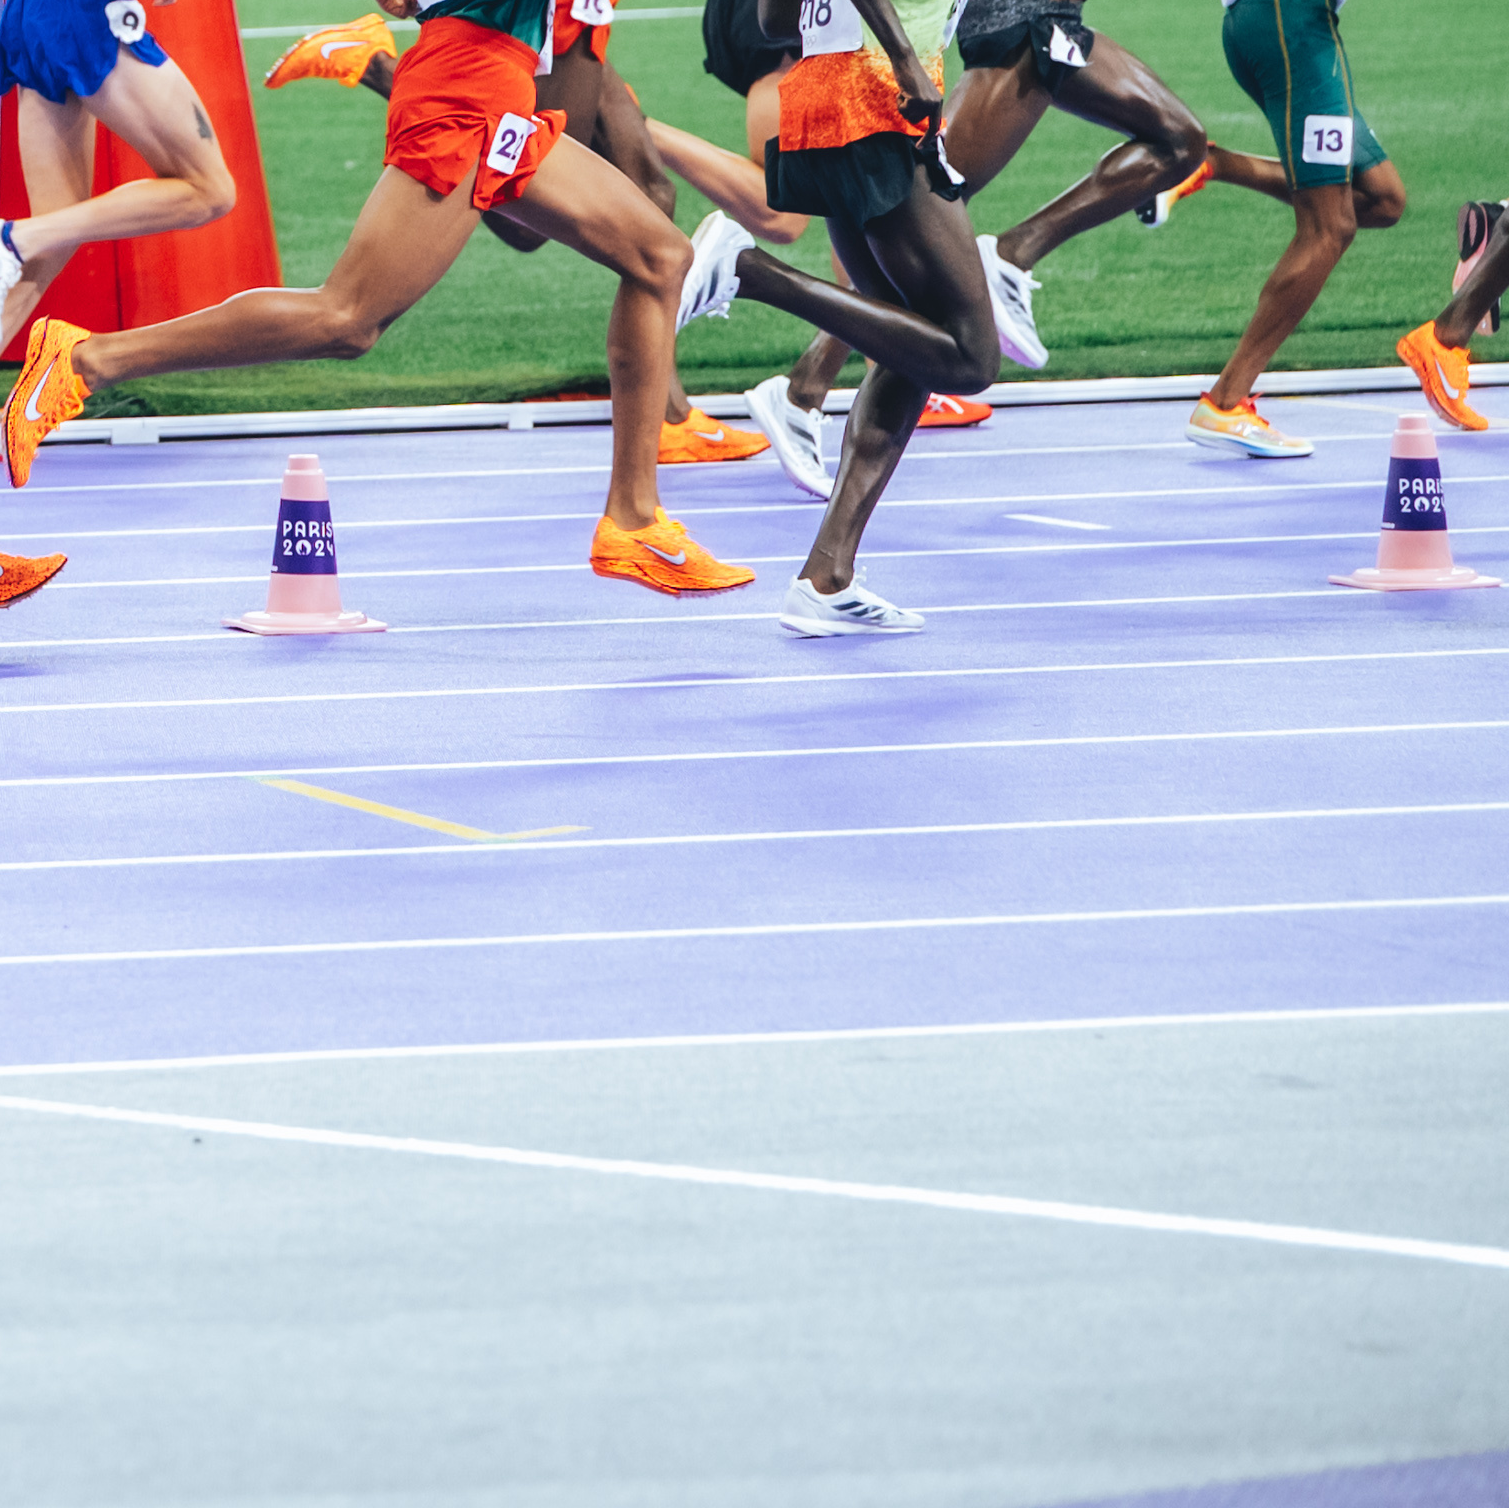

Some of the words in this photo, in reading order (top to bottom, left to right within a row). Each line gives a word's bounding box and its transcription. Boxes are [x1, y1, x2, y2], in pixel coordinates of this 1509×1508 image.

[1313, 129, 1343, 152] 13
[283, 520, 333, 538] PARIS
[283, 539, 334, 557] 2024
